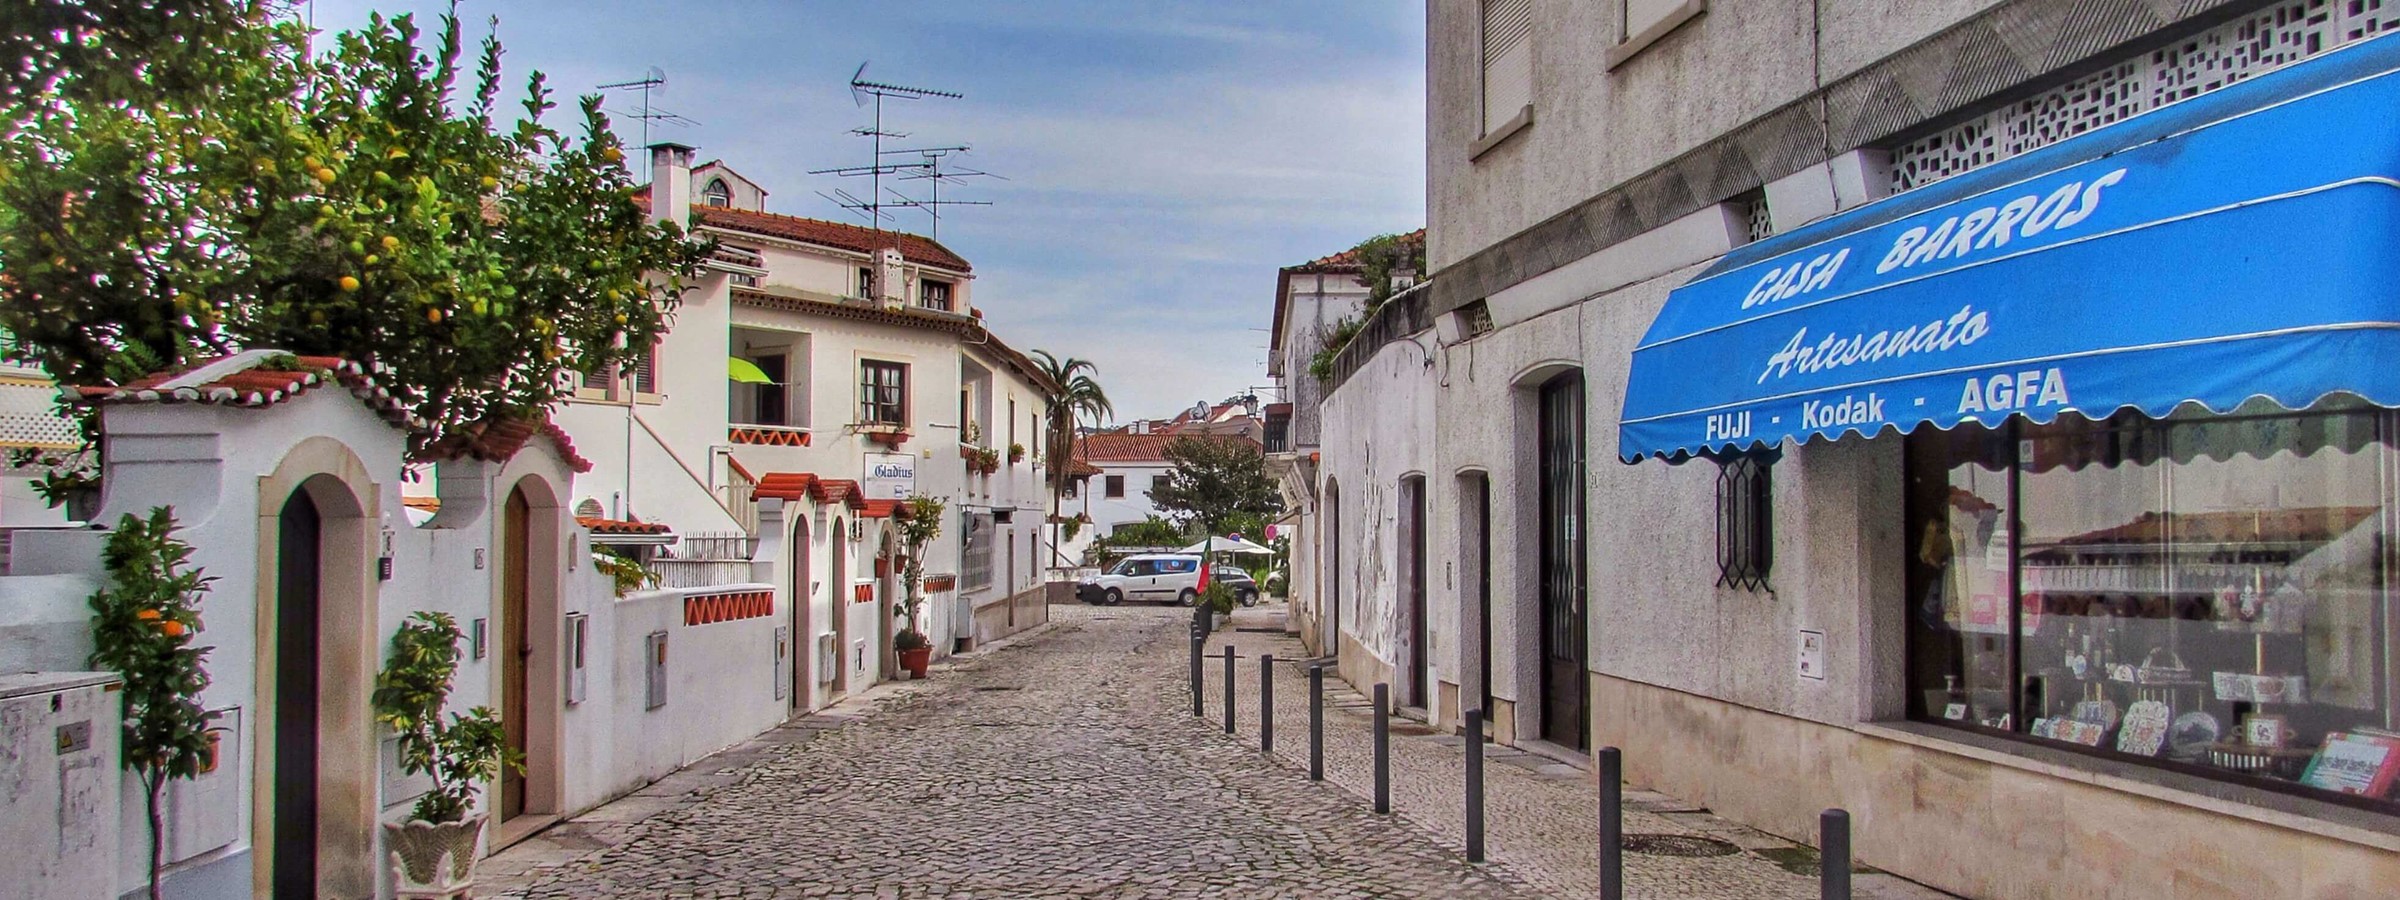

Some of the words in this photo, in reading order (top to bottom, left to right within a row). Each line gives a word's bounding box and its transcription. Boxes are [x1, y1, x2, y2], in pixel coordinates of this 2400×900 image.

[1742, 248, 1850, 309] CASA
[1876, 168, 2128, 274] BARROS
[1757, 304, 1989, 384] Artesanato
[1706, 411, 1751, 441] FUJI
[1802, 392, 1885, 429] Kodak
[1958, 367, 2070, 413] AGFA
[874, 464, 913, 478] Gladius
